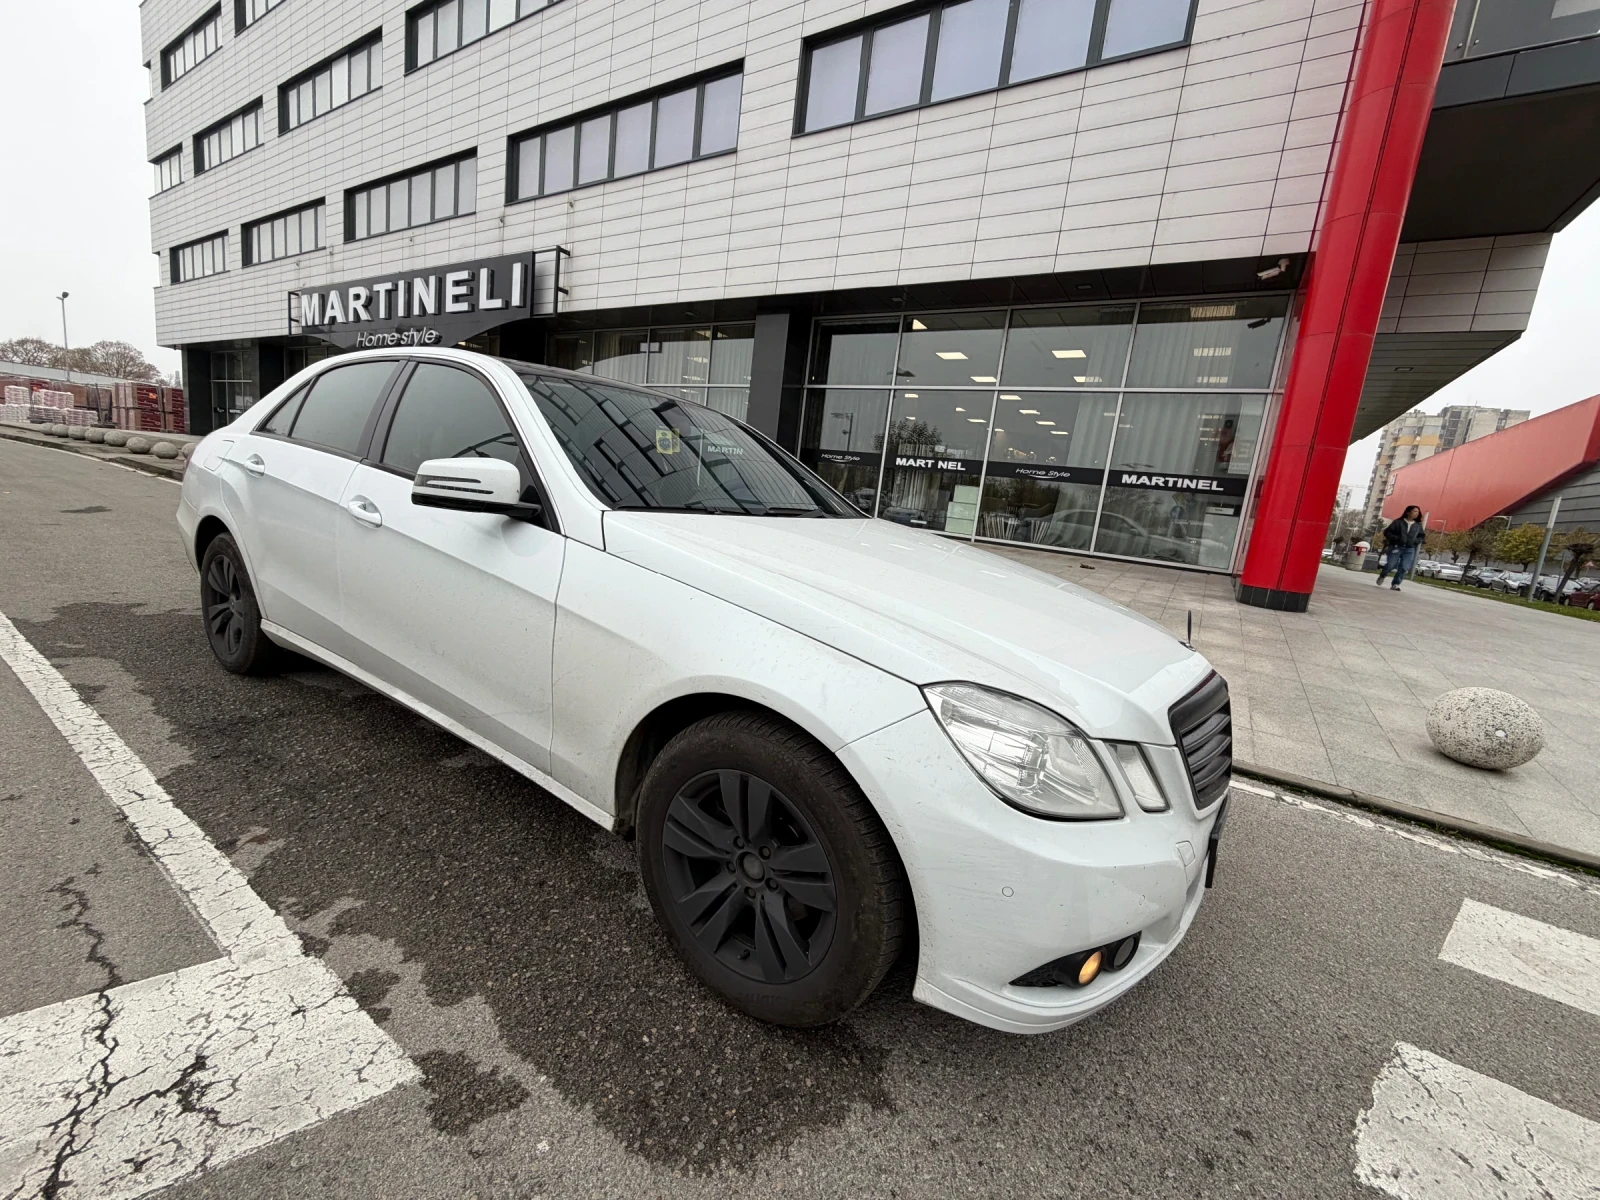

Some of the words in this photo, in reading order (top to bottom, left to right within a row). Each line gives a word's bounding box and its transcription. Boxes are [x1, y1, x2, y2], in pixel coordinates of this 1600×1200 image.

[301, 262, 526, 327] MARTINELI
[356, 331, 398, 348] Home
[400, 326, 438, 347] style
[708, 445, 744, 455] MARTIN
[1015, 467, 1046, 475] Home
[1047, 470, 1071, 478] Style
[1121, 473, 1225, 491] MARTINEL
